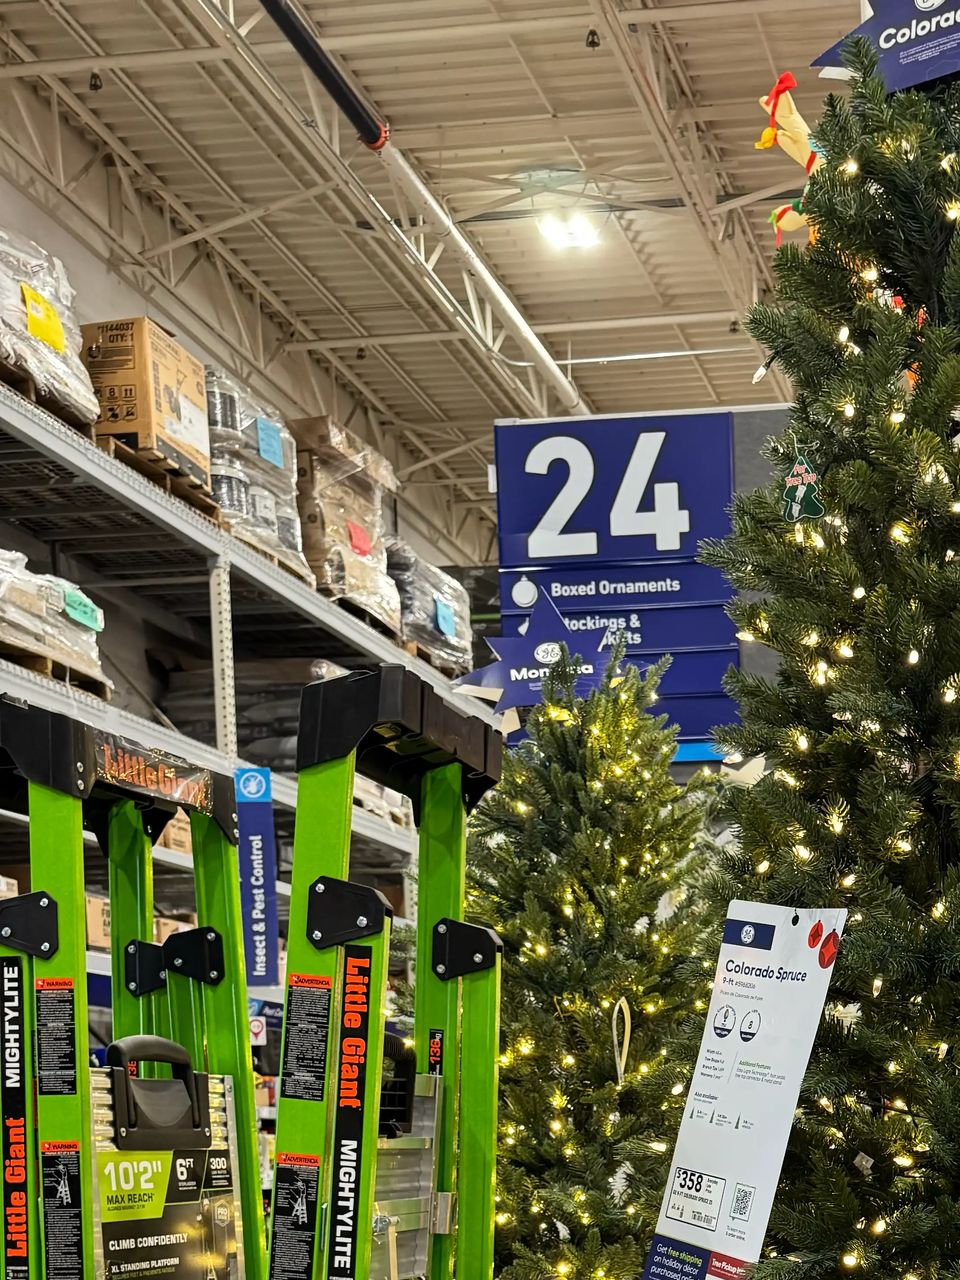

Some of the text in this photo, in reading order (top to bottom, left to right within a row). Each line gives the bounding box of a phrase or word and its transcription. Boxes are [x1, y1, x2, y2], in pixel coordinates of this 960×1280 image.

[525, 431, 690, 558] 24
[551, 578, 681, 597] Boxed Ornaments
[563, 615, 627, 632] tockings
[103, 743, 158, 791] Little
[249, 835, 266, 976] Insect & Pest Control
[725, 959, 807, 982] Colorado Spruce
[3, 966, 21, 1088] MIGHTYLITE
[339, 956, 370, 1108] Little Giant
[210, 1157, 227, 1170] 300
[5, 1117, 28, 1257] Giant Little
[677, 1170, 703, 1192] $358
[106, 1194, 126, 1205] MAX
[334, 1140, 358, 1269] MIGHTYLITE
[109, 1233, 188, 1251] CLIMB CONFIDENTLY
[111, 1257, 180, 1273] XL STANDING PLATFORM
[653, 1255, 661, 1263] on
[661, 1256, 683, 1271] holiday
[656, 1243, 703, 1266] Get free shipping
[650, 1265, 681, 1280] purchased
